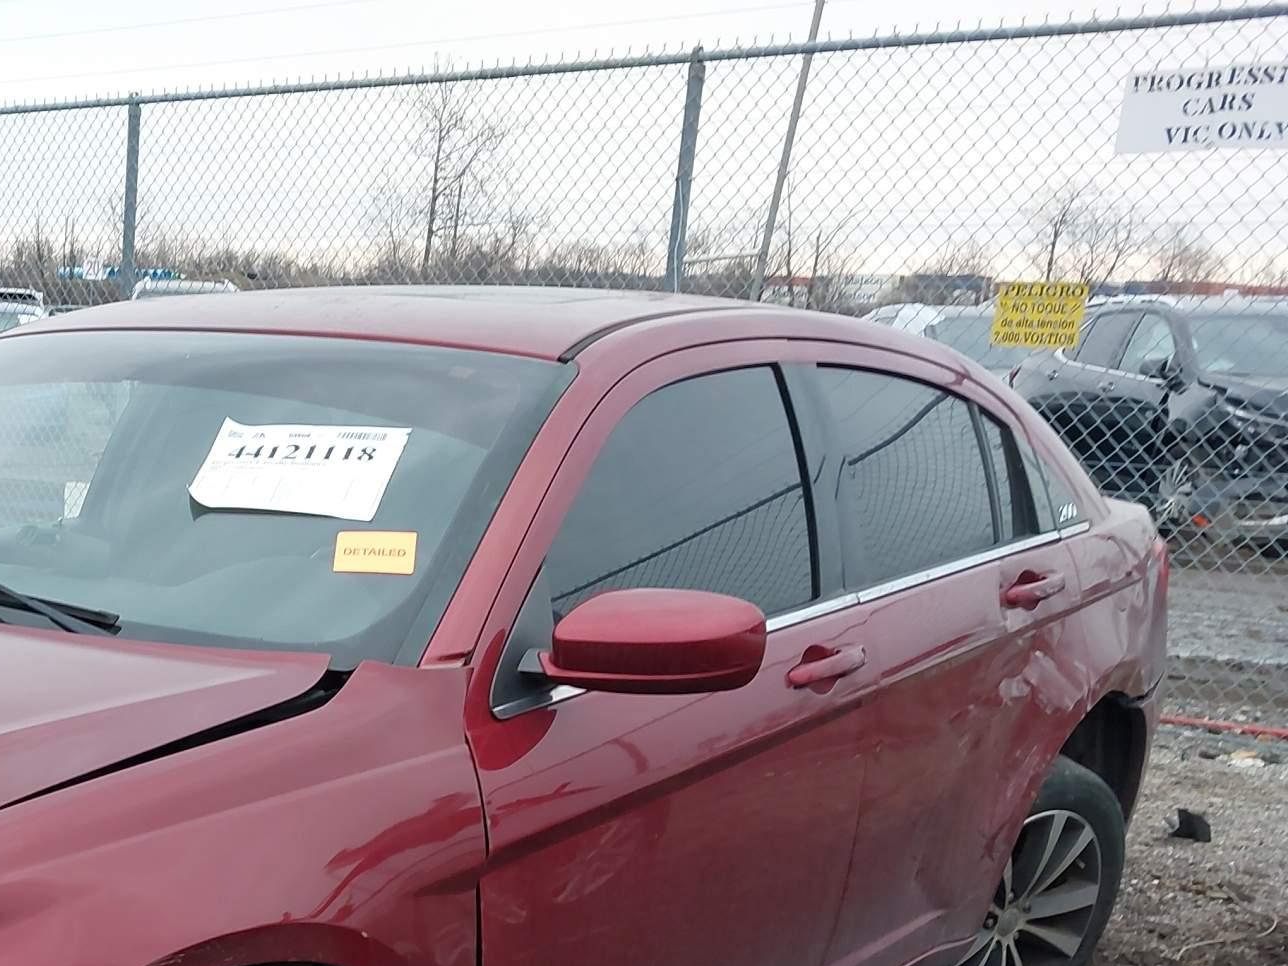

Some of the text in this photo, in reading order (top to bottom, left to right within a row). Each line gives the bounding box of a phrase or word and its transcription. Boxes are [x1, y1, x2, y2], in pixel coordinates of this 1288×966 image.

[1182, 92, 1255, 116] CARS
[1004, 284, 1084, 297] PELIGRO
[1011, 302, 1067, 315] NO TOQUE
[227, 444, 377, 462] 44121118
[343, 547, 407, 558] DETAILED
